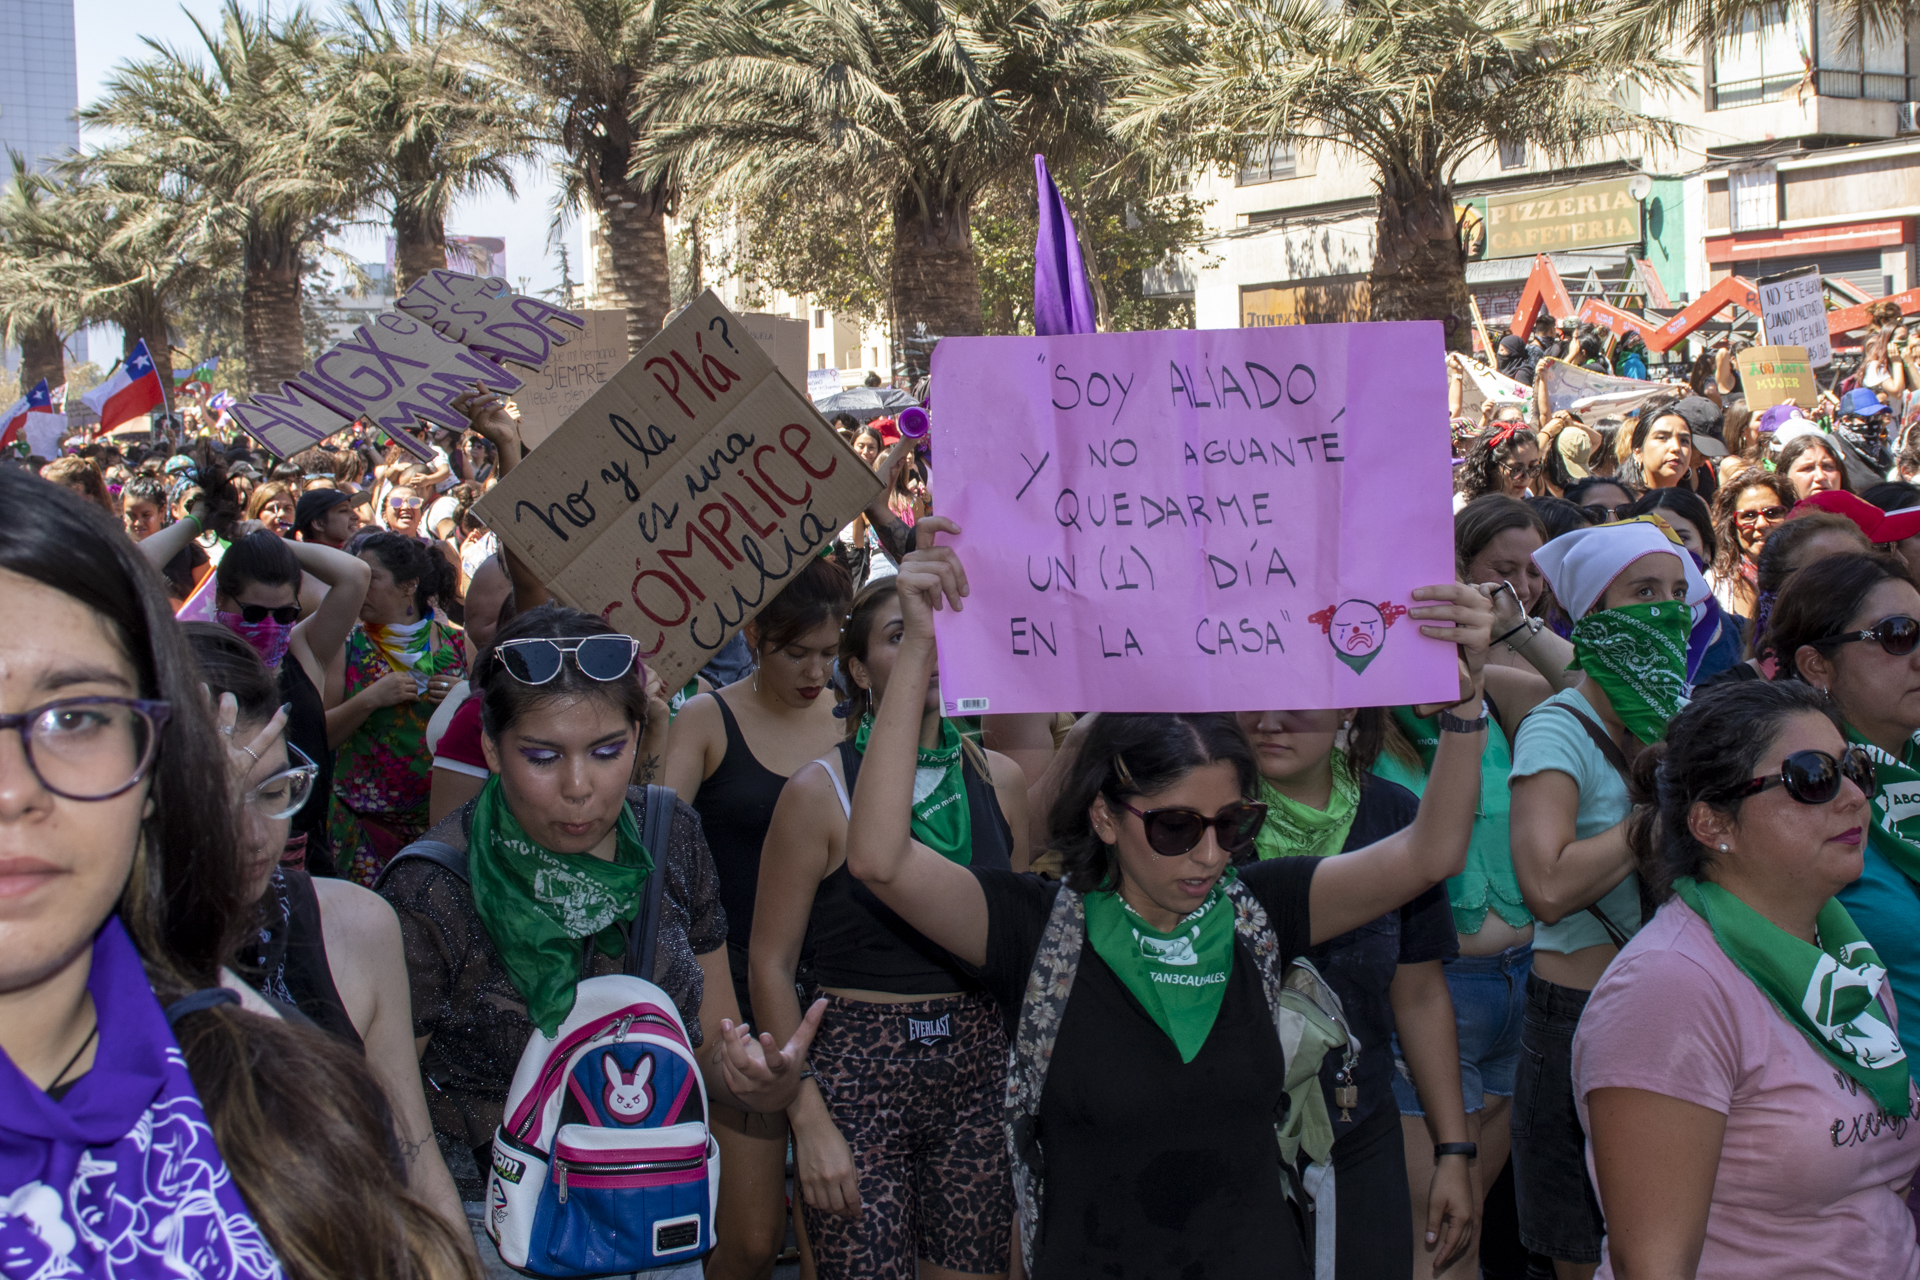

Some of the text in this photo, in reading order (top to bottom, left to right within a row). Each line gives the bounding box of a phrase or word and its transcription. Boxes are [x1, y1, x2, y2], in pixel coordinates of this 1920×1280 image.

[1490, 190, 1635, 225] PIZZERIA
[1490, 216, 1636, 250] CAFETERIA
[1766, 287, 1781, 307] NO
[1784, 283, 1796, 304] SE
[230, 326, 430, 458] AMIGX
[378, 298, 586, 459] MANADA
[543, 362, 609, 390] SIEMPRE
[1756, 377, 1800, 390] MUJER
[608, 413, 677, 469] la
[1015, 407, 1346, 501] Y NO AGUANTÉ
[601, 460, 641, 502] y
[686, 432, 755, 500] una
[1054, 487, 1273, 533] QUEDARME
[1207, 539, 1297, 590] DÍA
[1010, 617, 1058, 658] EN
[1100, 625, 1144, 659] LA
[908, 1013, 952, 1041] EVERLAST
